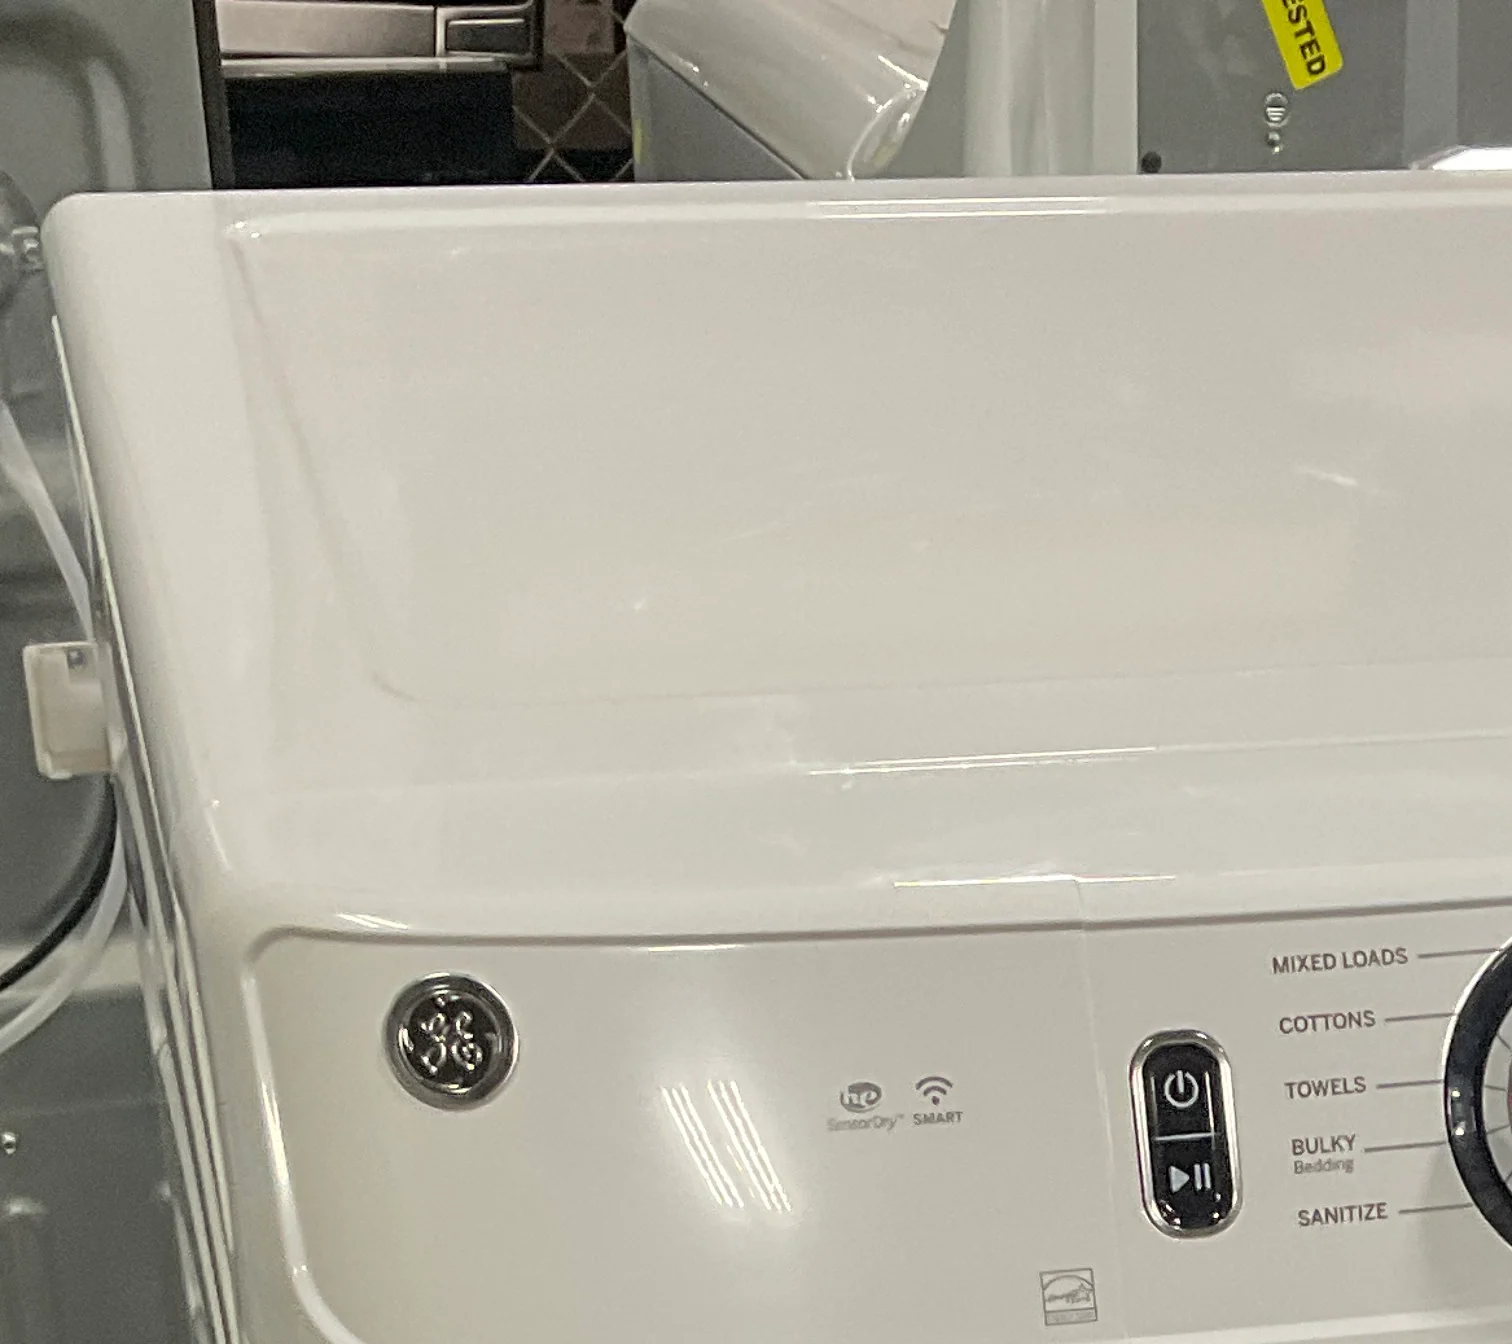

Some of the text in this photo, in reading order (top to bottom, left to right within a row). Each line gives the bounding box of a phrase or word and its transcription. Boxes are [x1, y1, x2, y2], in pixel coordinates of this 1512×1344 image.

[1272, 947, 1408, 974] MIXED LOADS
[1279, 1010, 1376, 1034] COTTONS
[1284, 1076, 1366, 1099] TOWELS
[913, 1111, 963, 1126] SMART
[1291, 1134, 1356, 1156] BULKY
[1293, 1158, 1354, 1175] Bedding
[1297, 1202, 1388, 1227] SANITIZE
